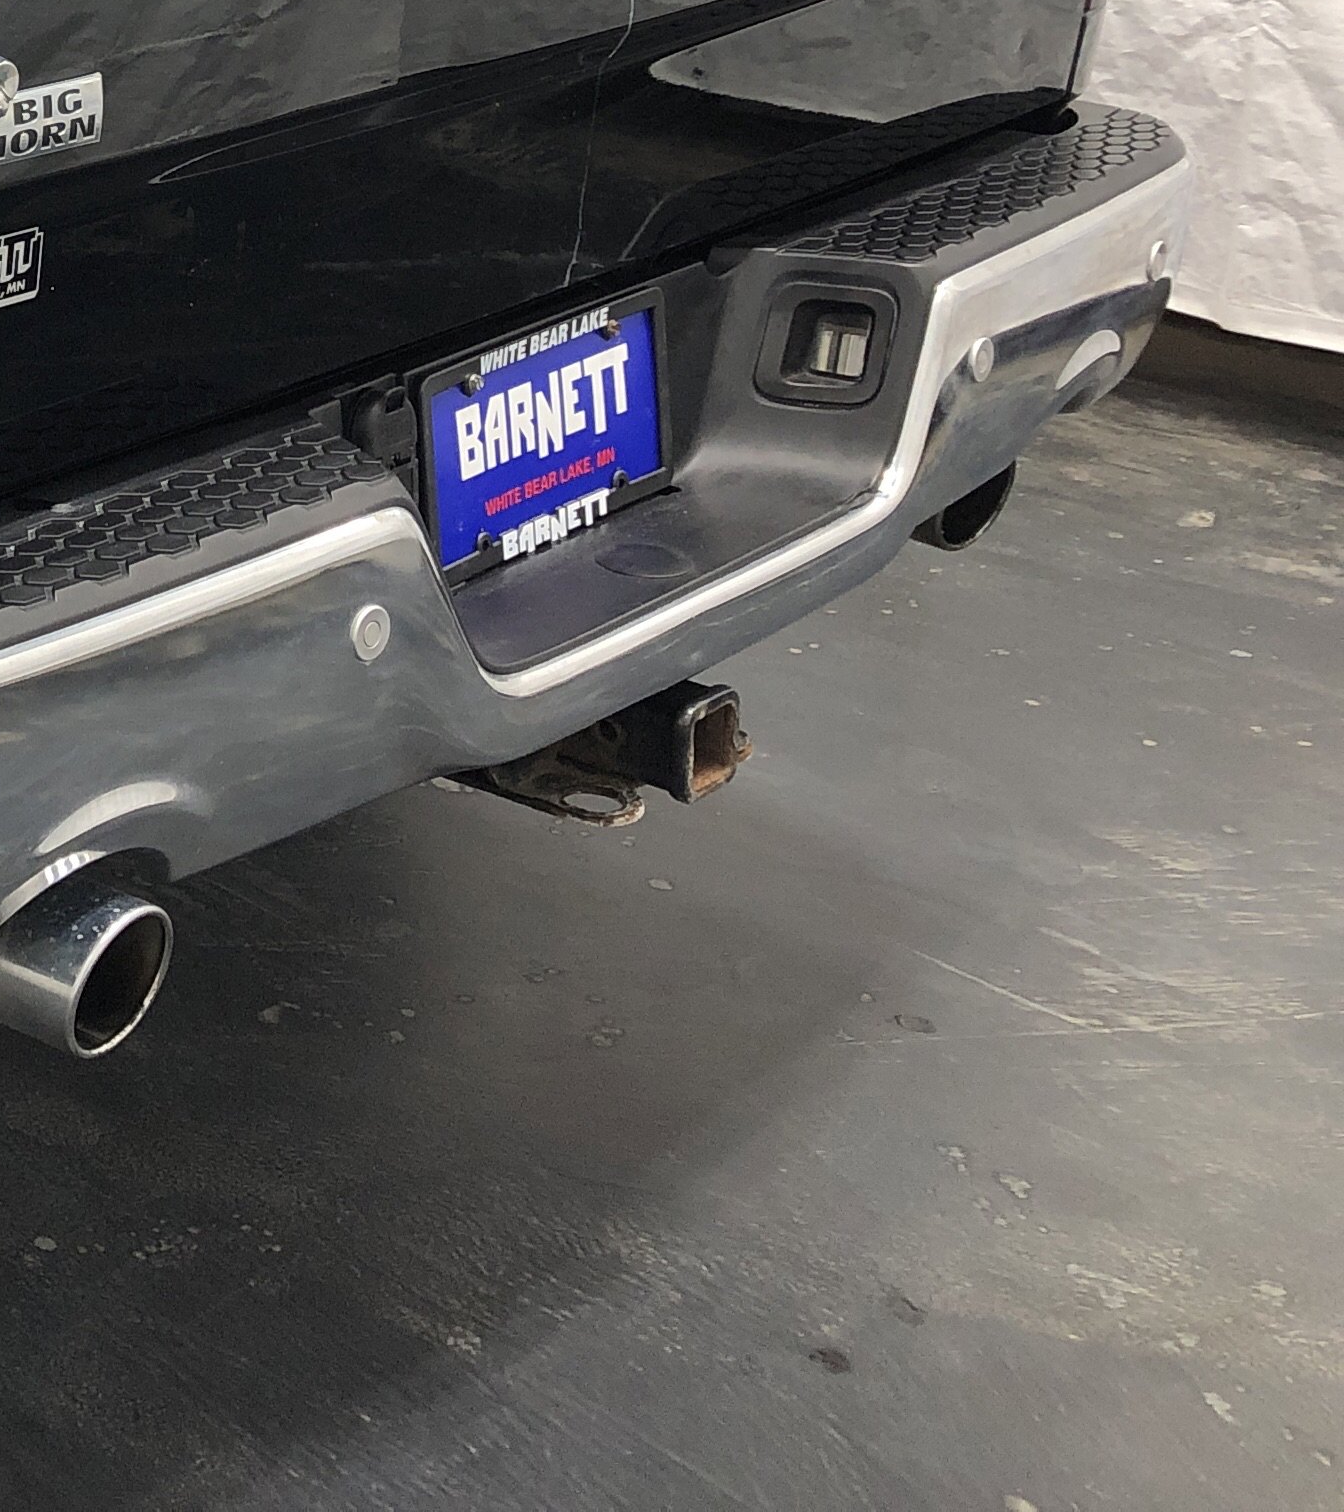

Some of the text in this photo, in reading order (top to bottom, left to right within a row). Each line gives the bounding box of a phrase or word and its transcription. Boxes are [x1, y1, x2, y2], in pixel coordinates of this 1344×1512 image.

[13, 88, 83, 126] BIG
[6, 279, 26, 294] MN
[480, 306, 610, 376] WHITE BEAR LAKE
[455, 343, 629, 482] BARNETT
[485, 445, 616, 517] WHITE BEAR LAKE, MN
[500, 488, 611, 561] BARNETT
